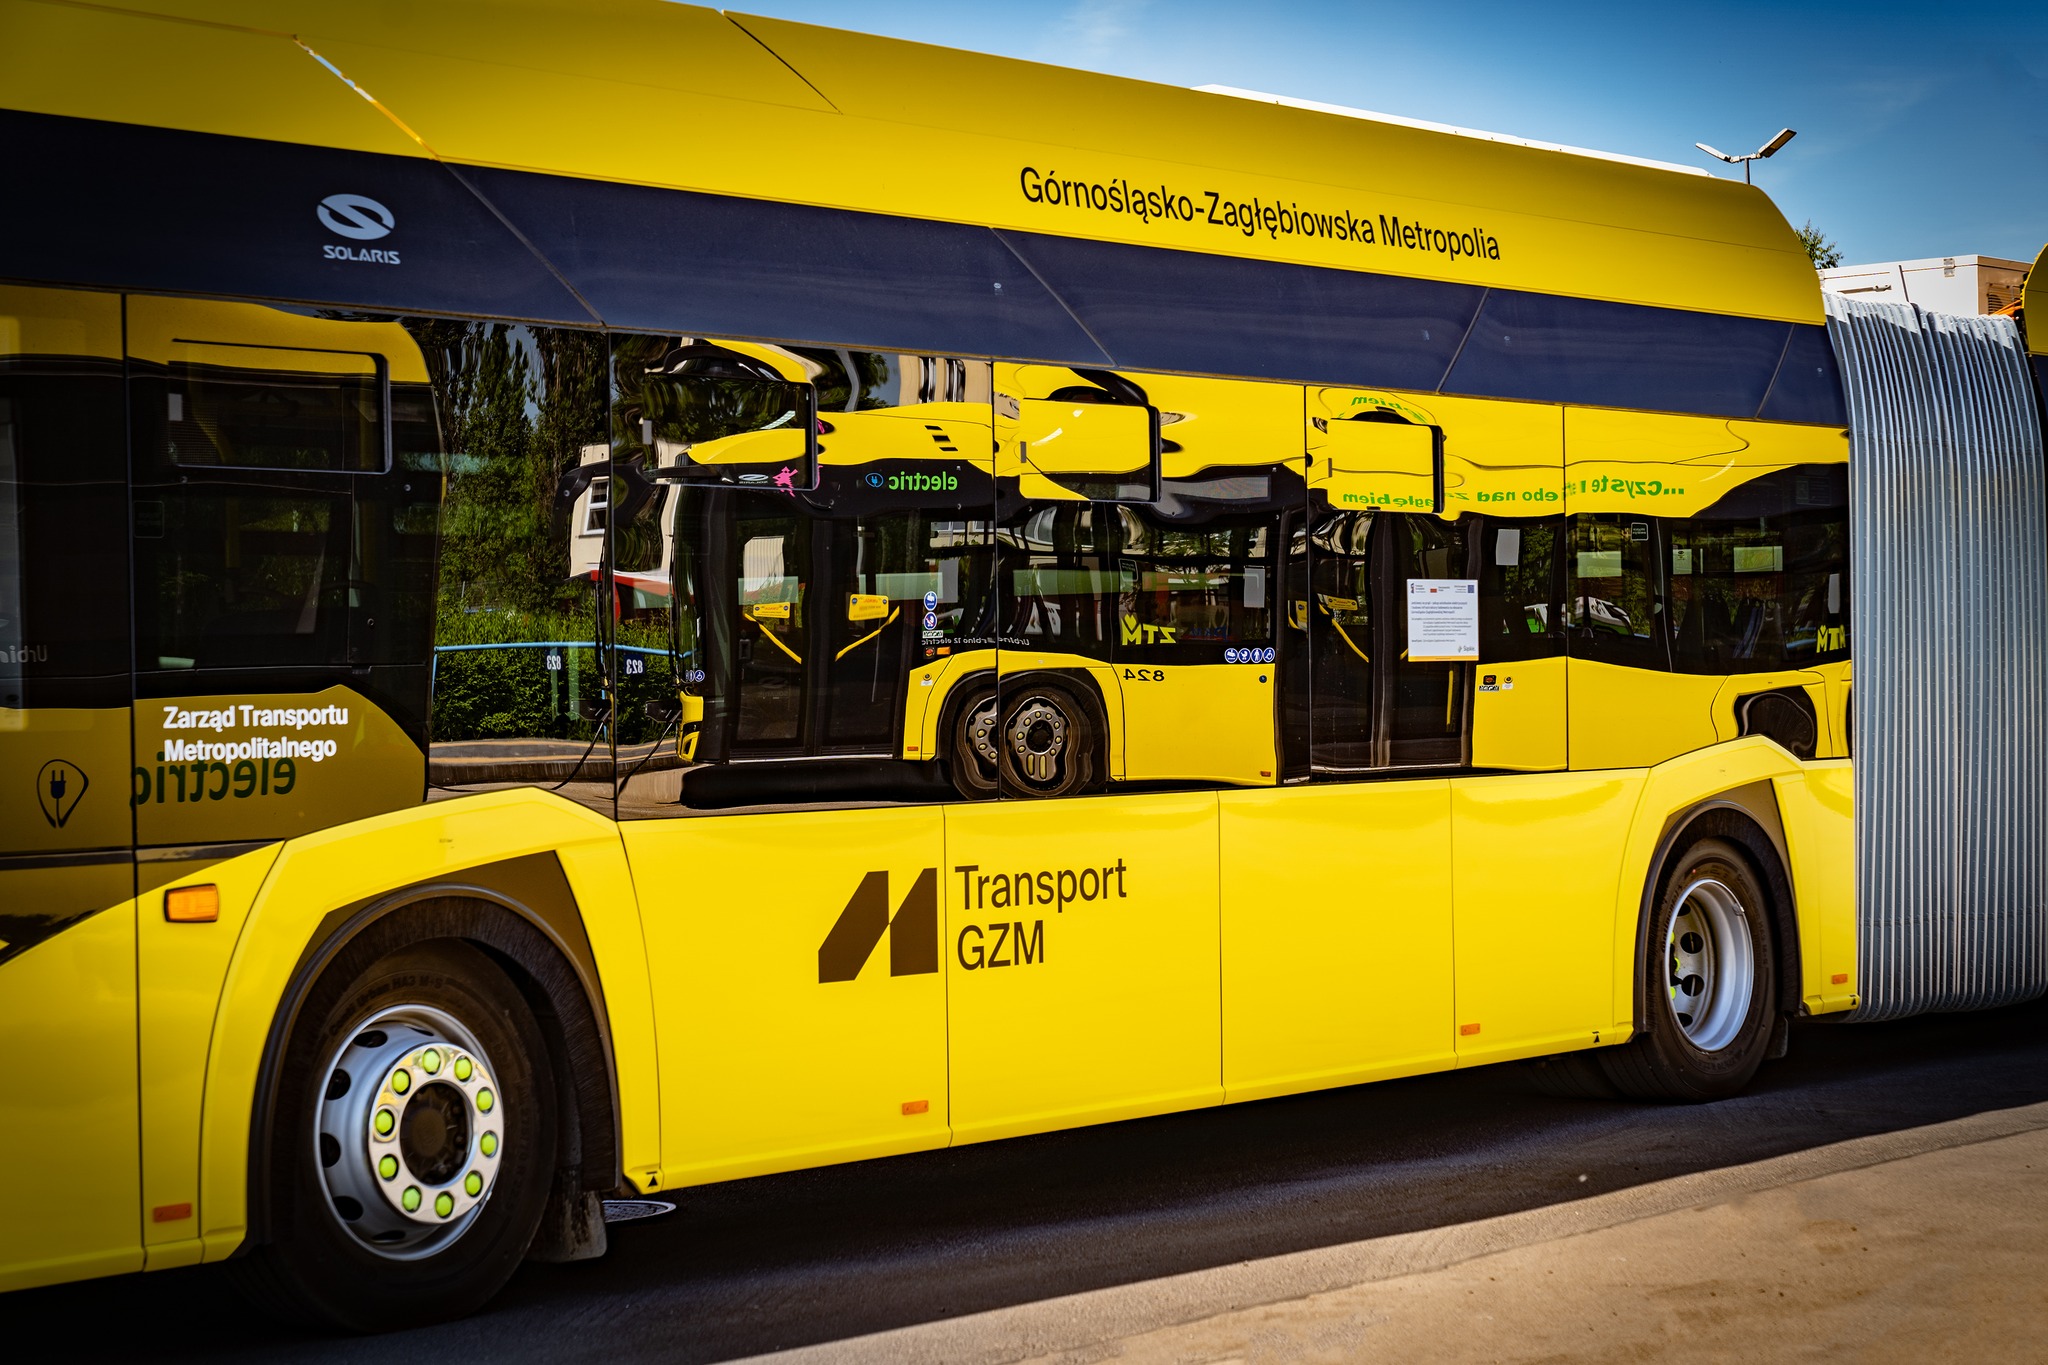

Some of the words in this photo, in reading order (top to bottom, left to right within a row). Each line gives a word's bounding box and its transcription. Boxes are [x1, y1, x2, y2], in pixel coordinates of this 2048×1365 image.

[1019, 166, 1376, 244] Górnośląsko-Zagłębiowska
[1378, 213, 1501, 261] Metropolia
[322, 244, 401, 265] SOLARIS
[163, 706, 235, 732] Zarząd
[238, 704, 349, 730] Transportu
[163, 736, 337, 764] Metropolitalnego
[954, 858, 1127, 913] Transport
[957, 919, 1044, 971] GZM
